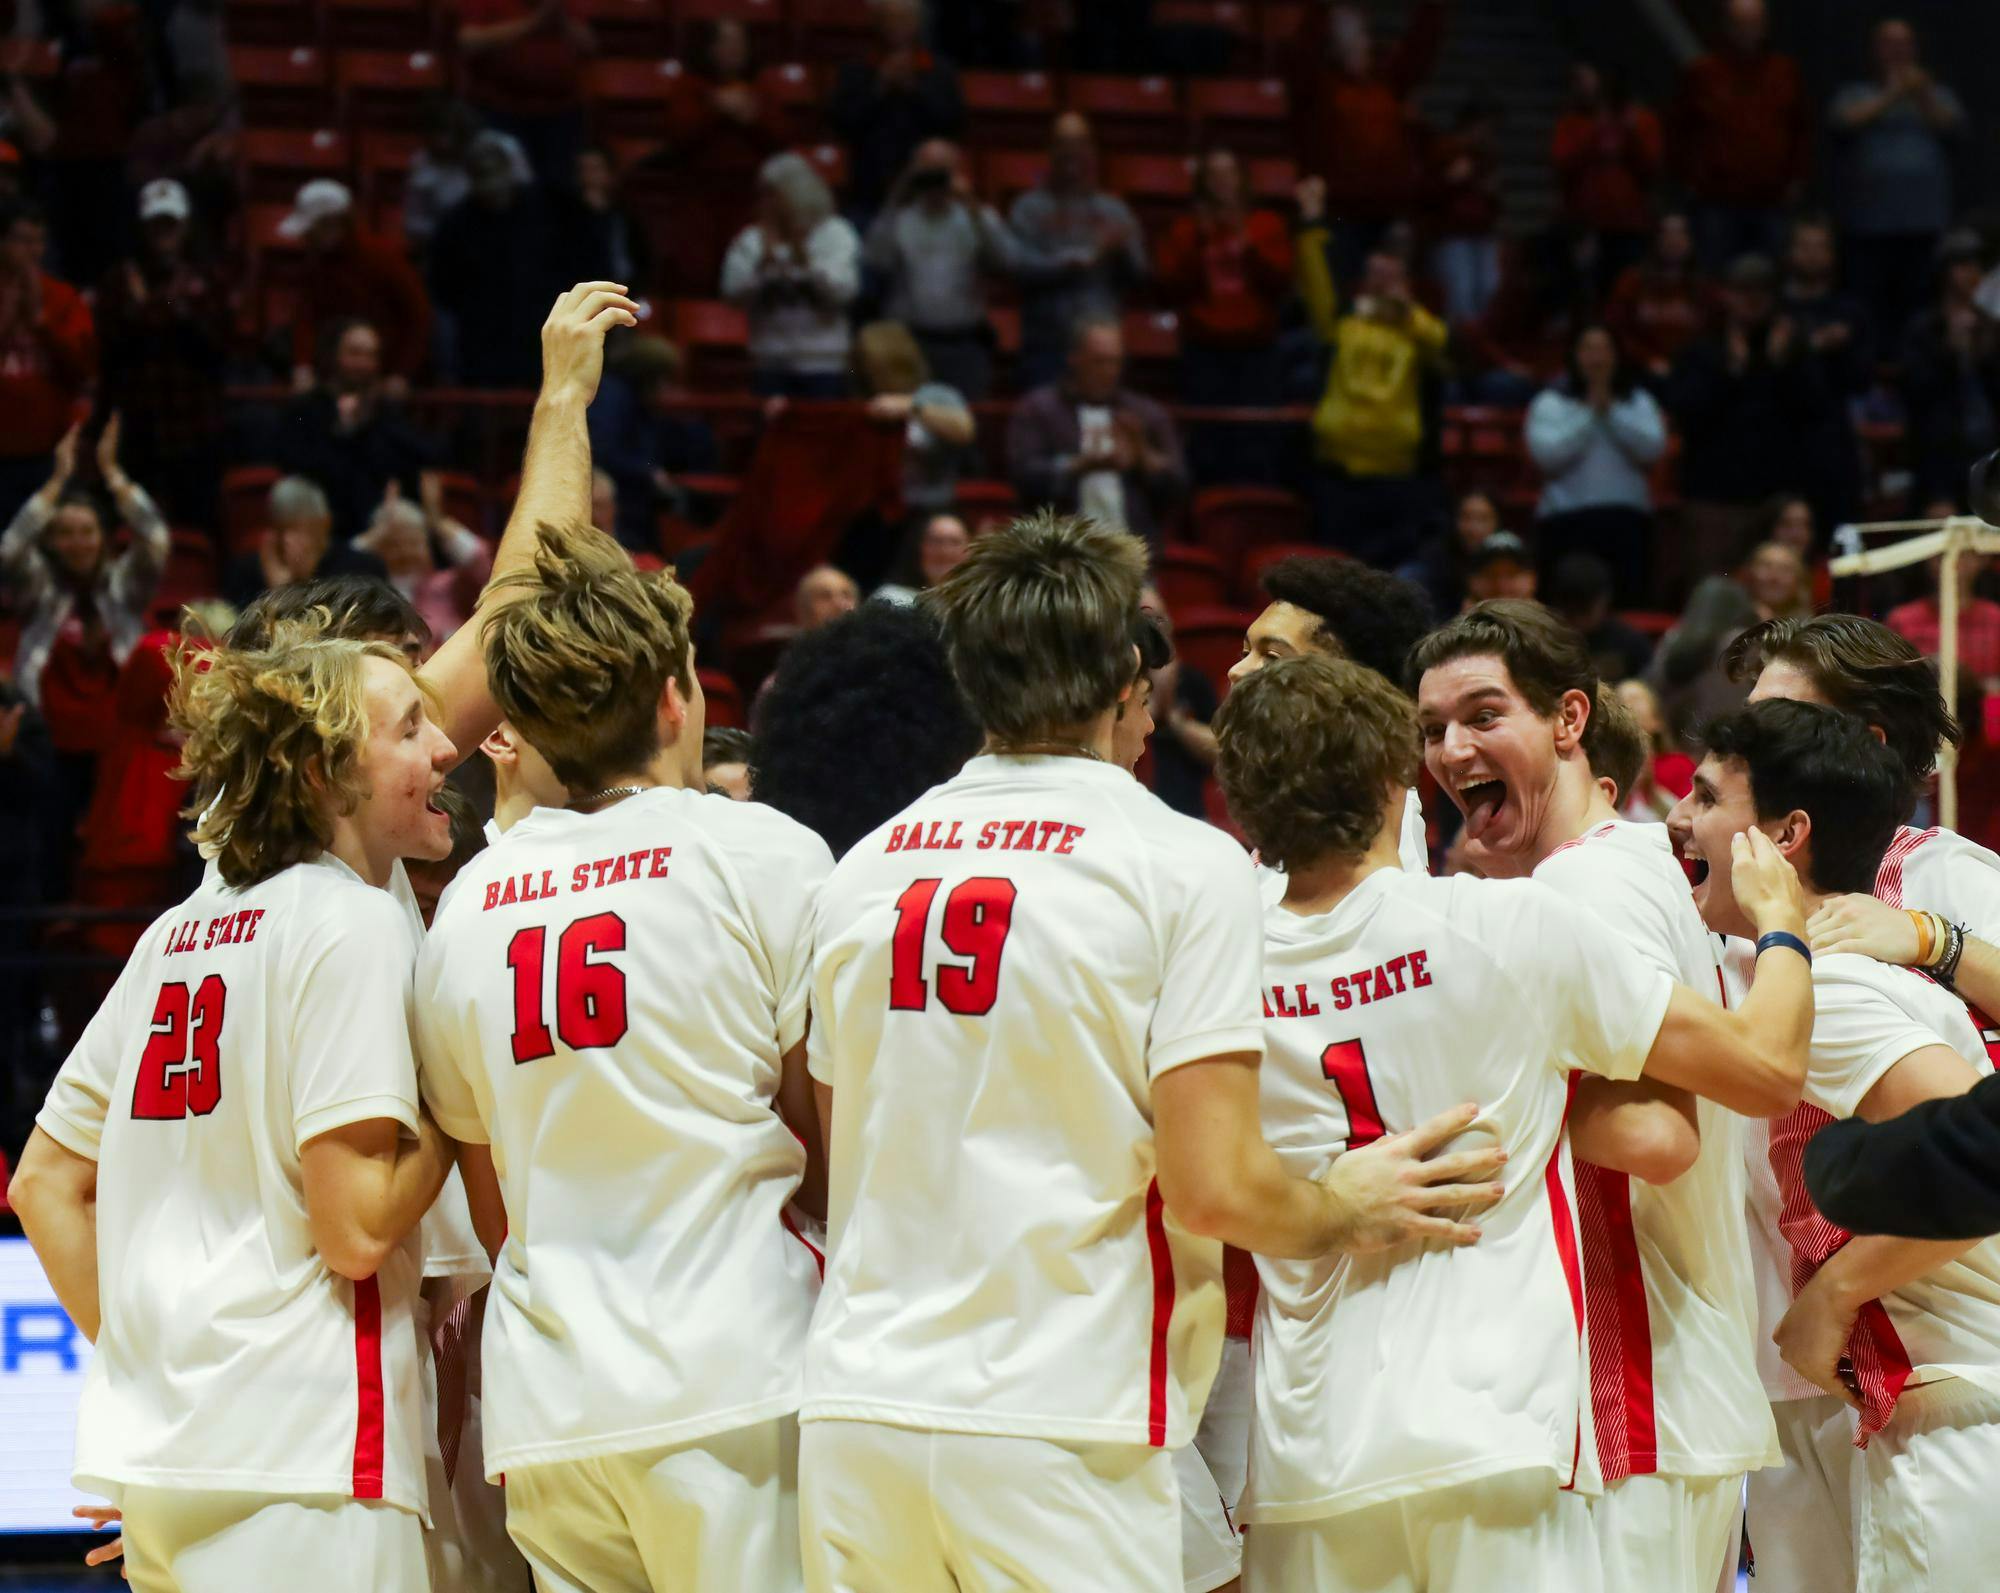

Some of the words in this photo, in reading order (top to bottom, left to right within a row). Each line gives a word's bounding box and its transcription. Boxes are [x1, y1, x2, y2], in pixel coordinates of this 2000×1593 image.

[884, 821, 963, 854] BALL
[976, 820, 1086, 855] STATE
[483, 870, 558, 912] BALL
[571, 847, 672, 893] STATE
[163, 920, 200, 957] LL
[203, 909, 265, 951] STATE
[889, 876, 1018, 1017] 19
[506, 910, 628, 1065] 16
[1331, 949, 1433, 1011] STATE
[130, 973, 227, 1120] 23
[1320, 1037, 1387, 1151] 1
[3, 1304, 79, 1372] R
